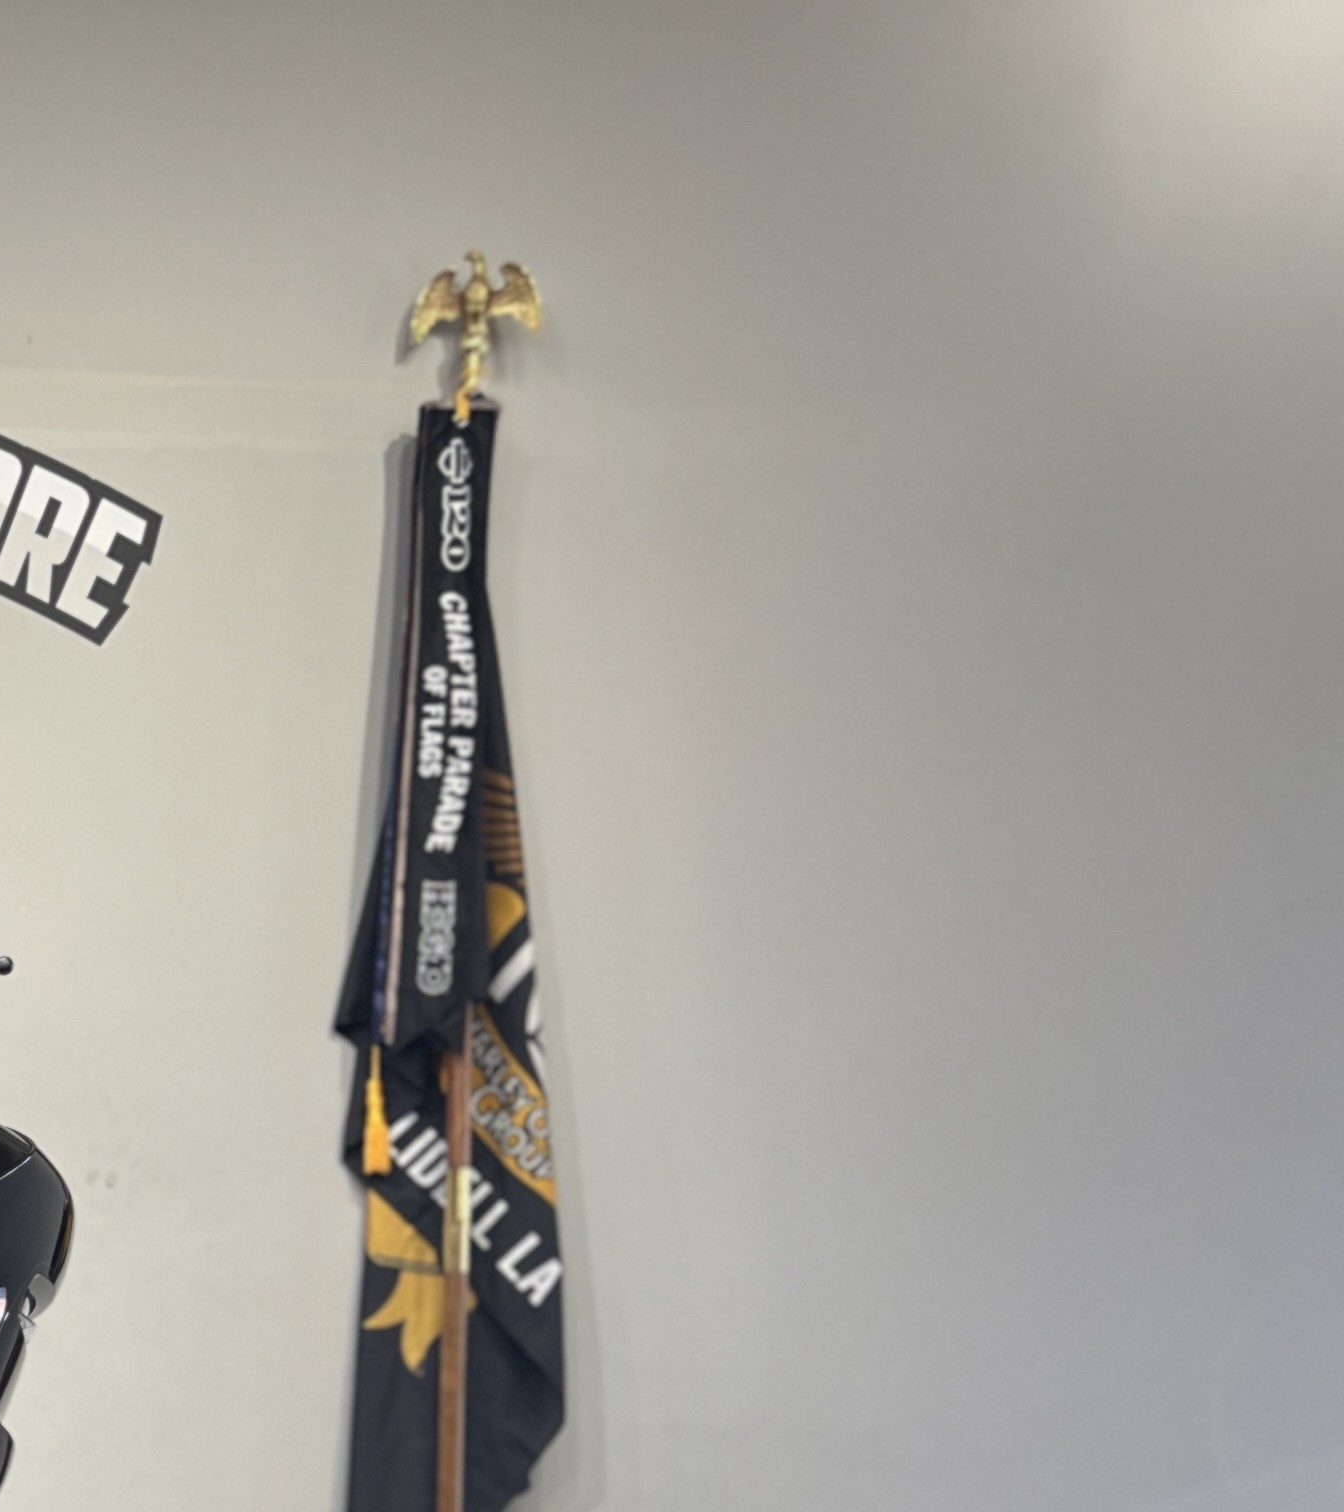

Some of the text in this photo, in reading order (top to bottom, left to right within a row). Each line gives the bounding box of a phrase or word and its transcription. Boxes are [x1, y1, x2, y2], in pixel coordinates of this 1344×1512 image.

[438, 590, 477, 728] CHAPTER
[418, 664, 448, 780] OF FLAGS
[423, 731, 476, 855] PARADE
[496, 1233, 564, 1310] LA
